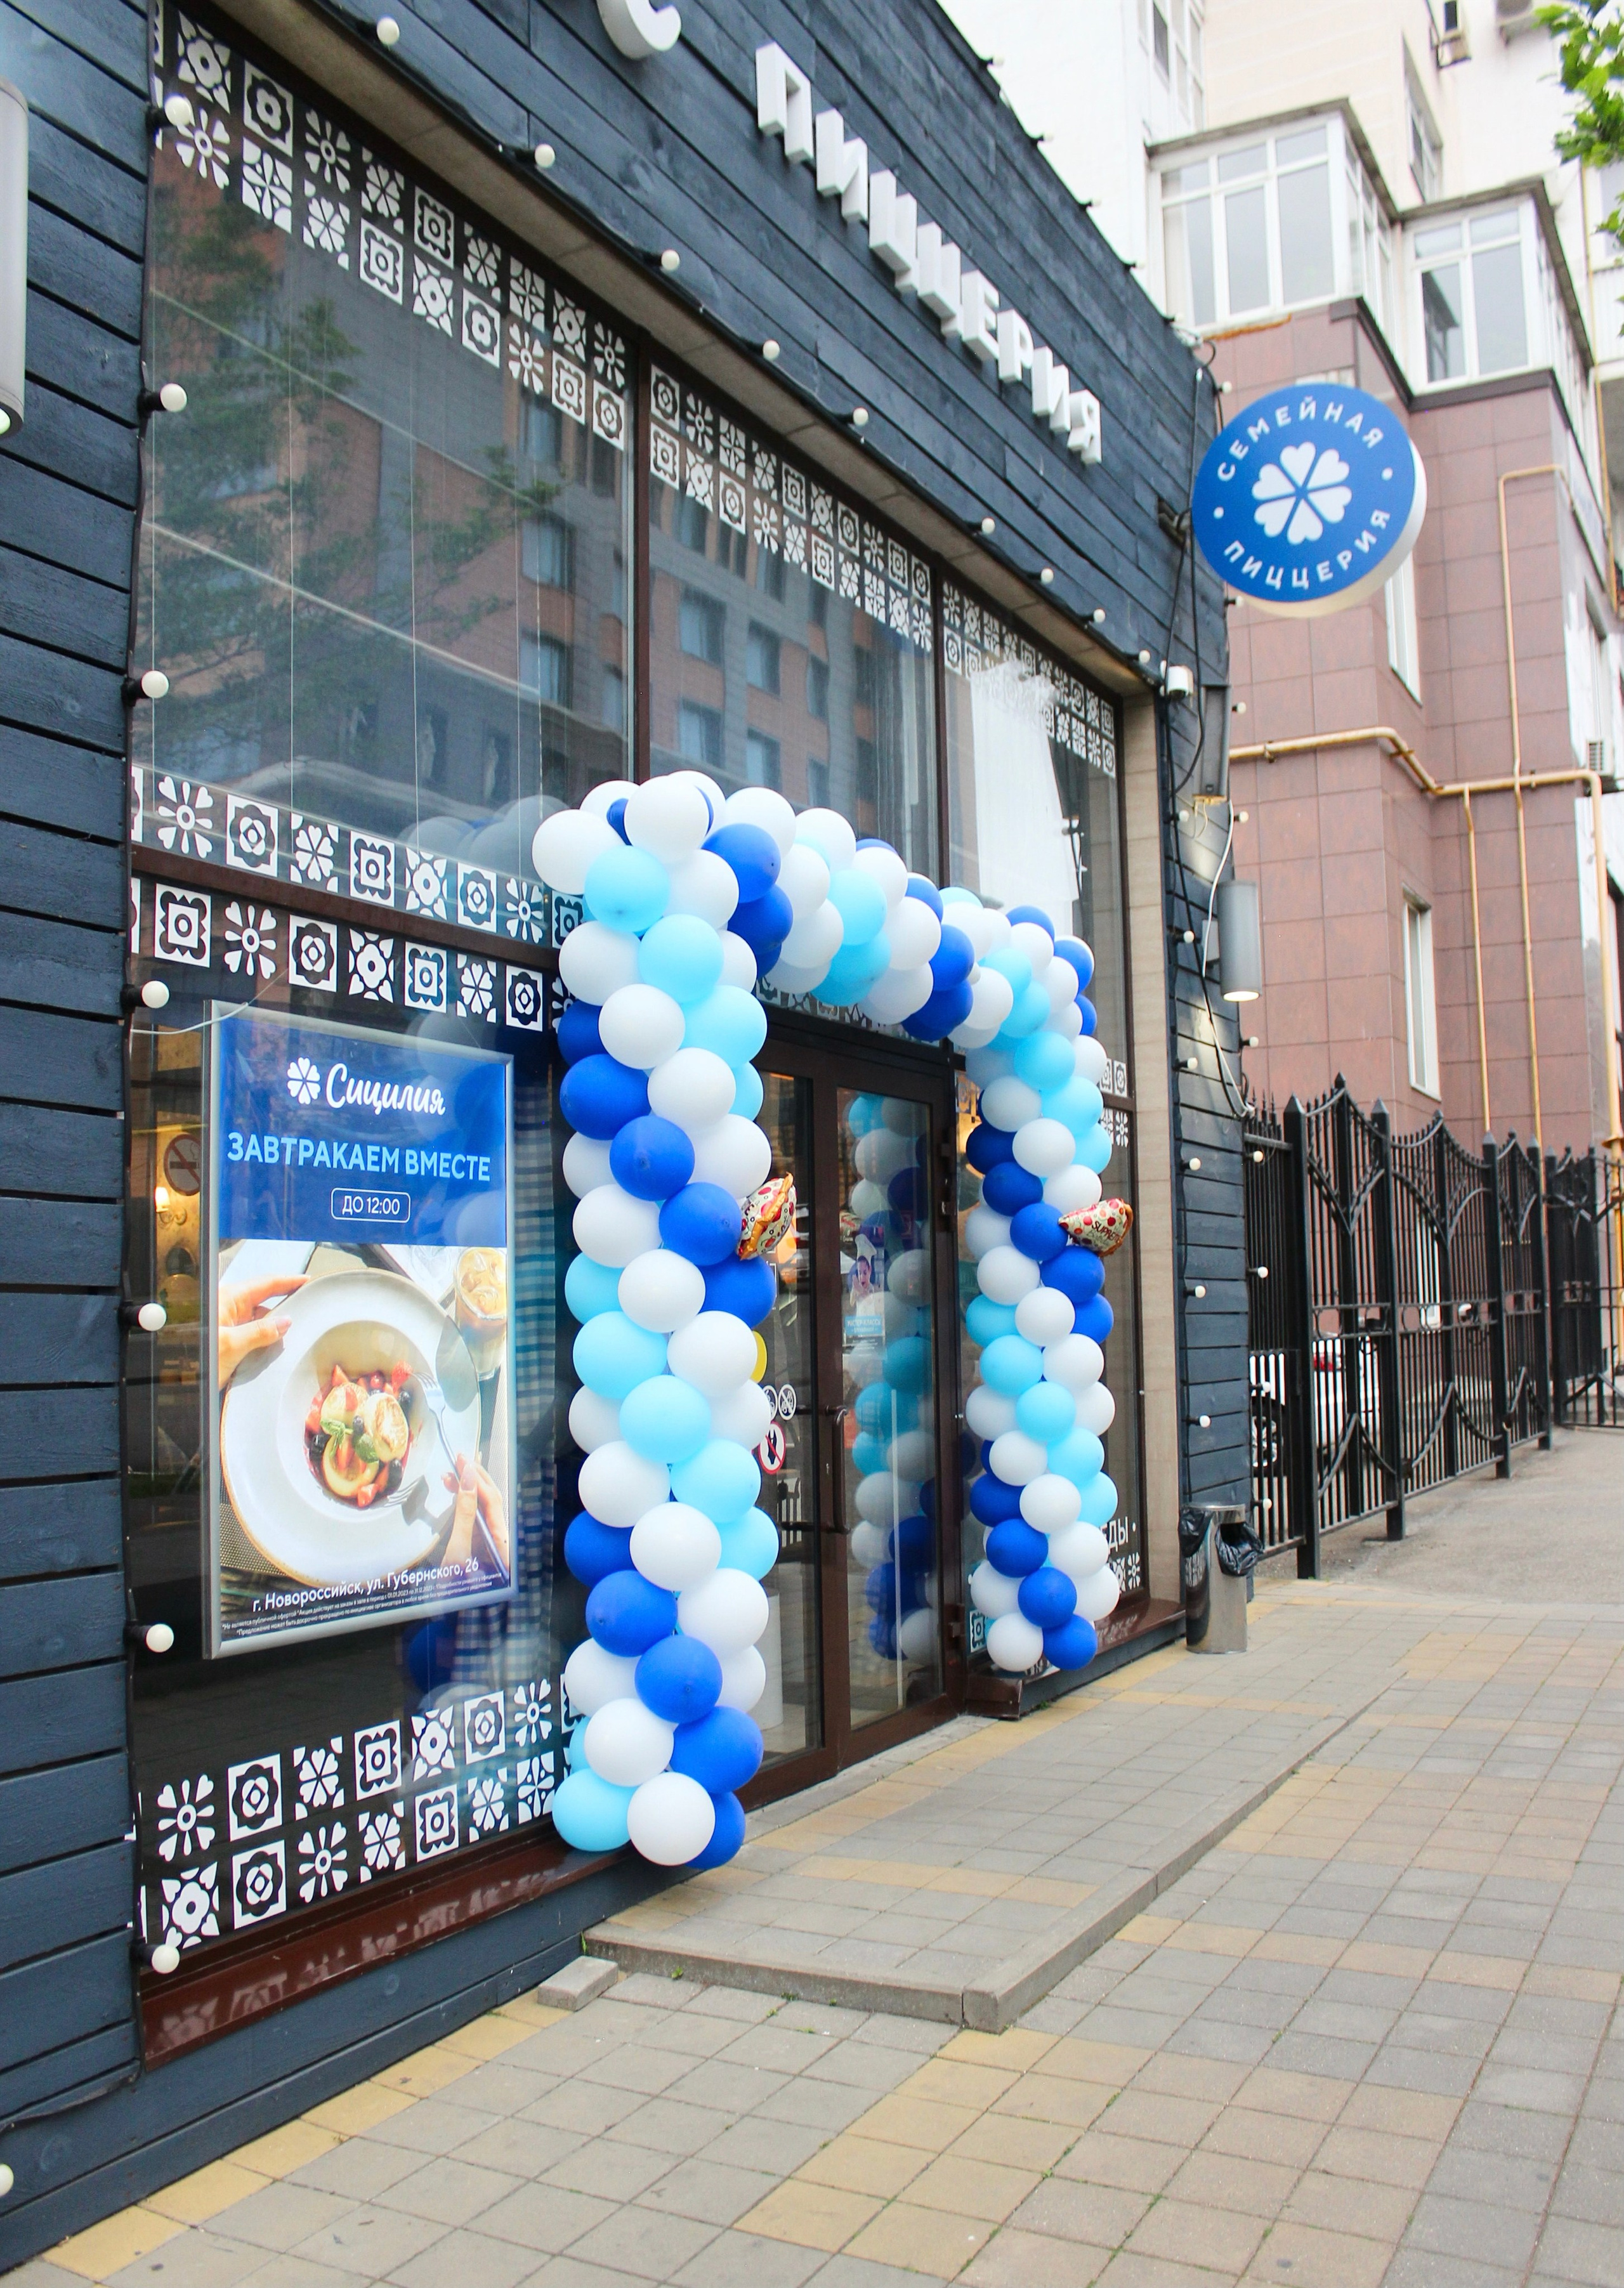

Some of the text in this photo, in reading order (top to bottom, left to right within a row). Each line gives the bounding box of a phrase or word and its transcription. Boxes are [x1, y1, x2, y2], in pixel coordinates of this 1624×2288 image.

[756, 42, 1102, 464] ПИЦЦЕРИЯ
[1217, 396, 1384, 481] СЕМЕЙНАЯ
[1224, 509, 1390, 590] ПИЦЦЕРИЯ
[325, 1062, 446, 1115] Сицилия
[227, 1132, 490, 1181] ЗАВТРАКАЕМ ВМЕСТЕ
[342, 1195, 400, 1215] ДО 12:00
[252, 1557, 479, 1612] г. Новороссийск, ул. Губернского, 26
